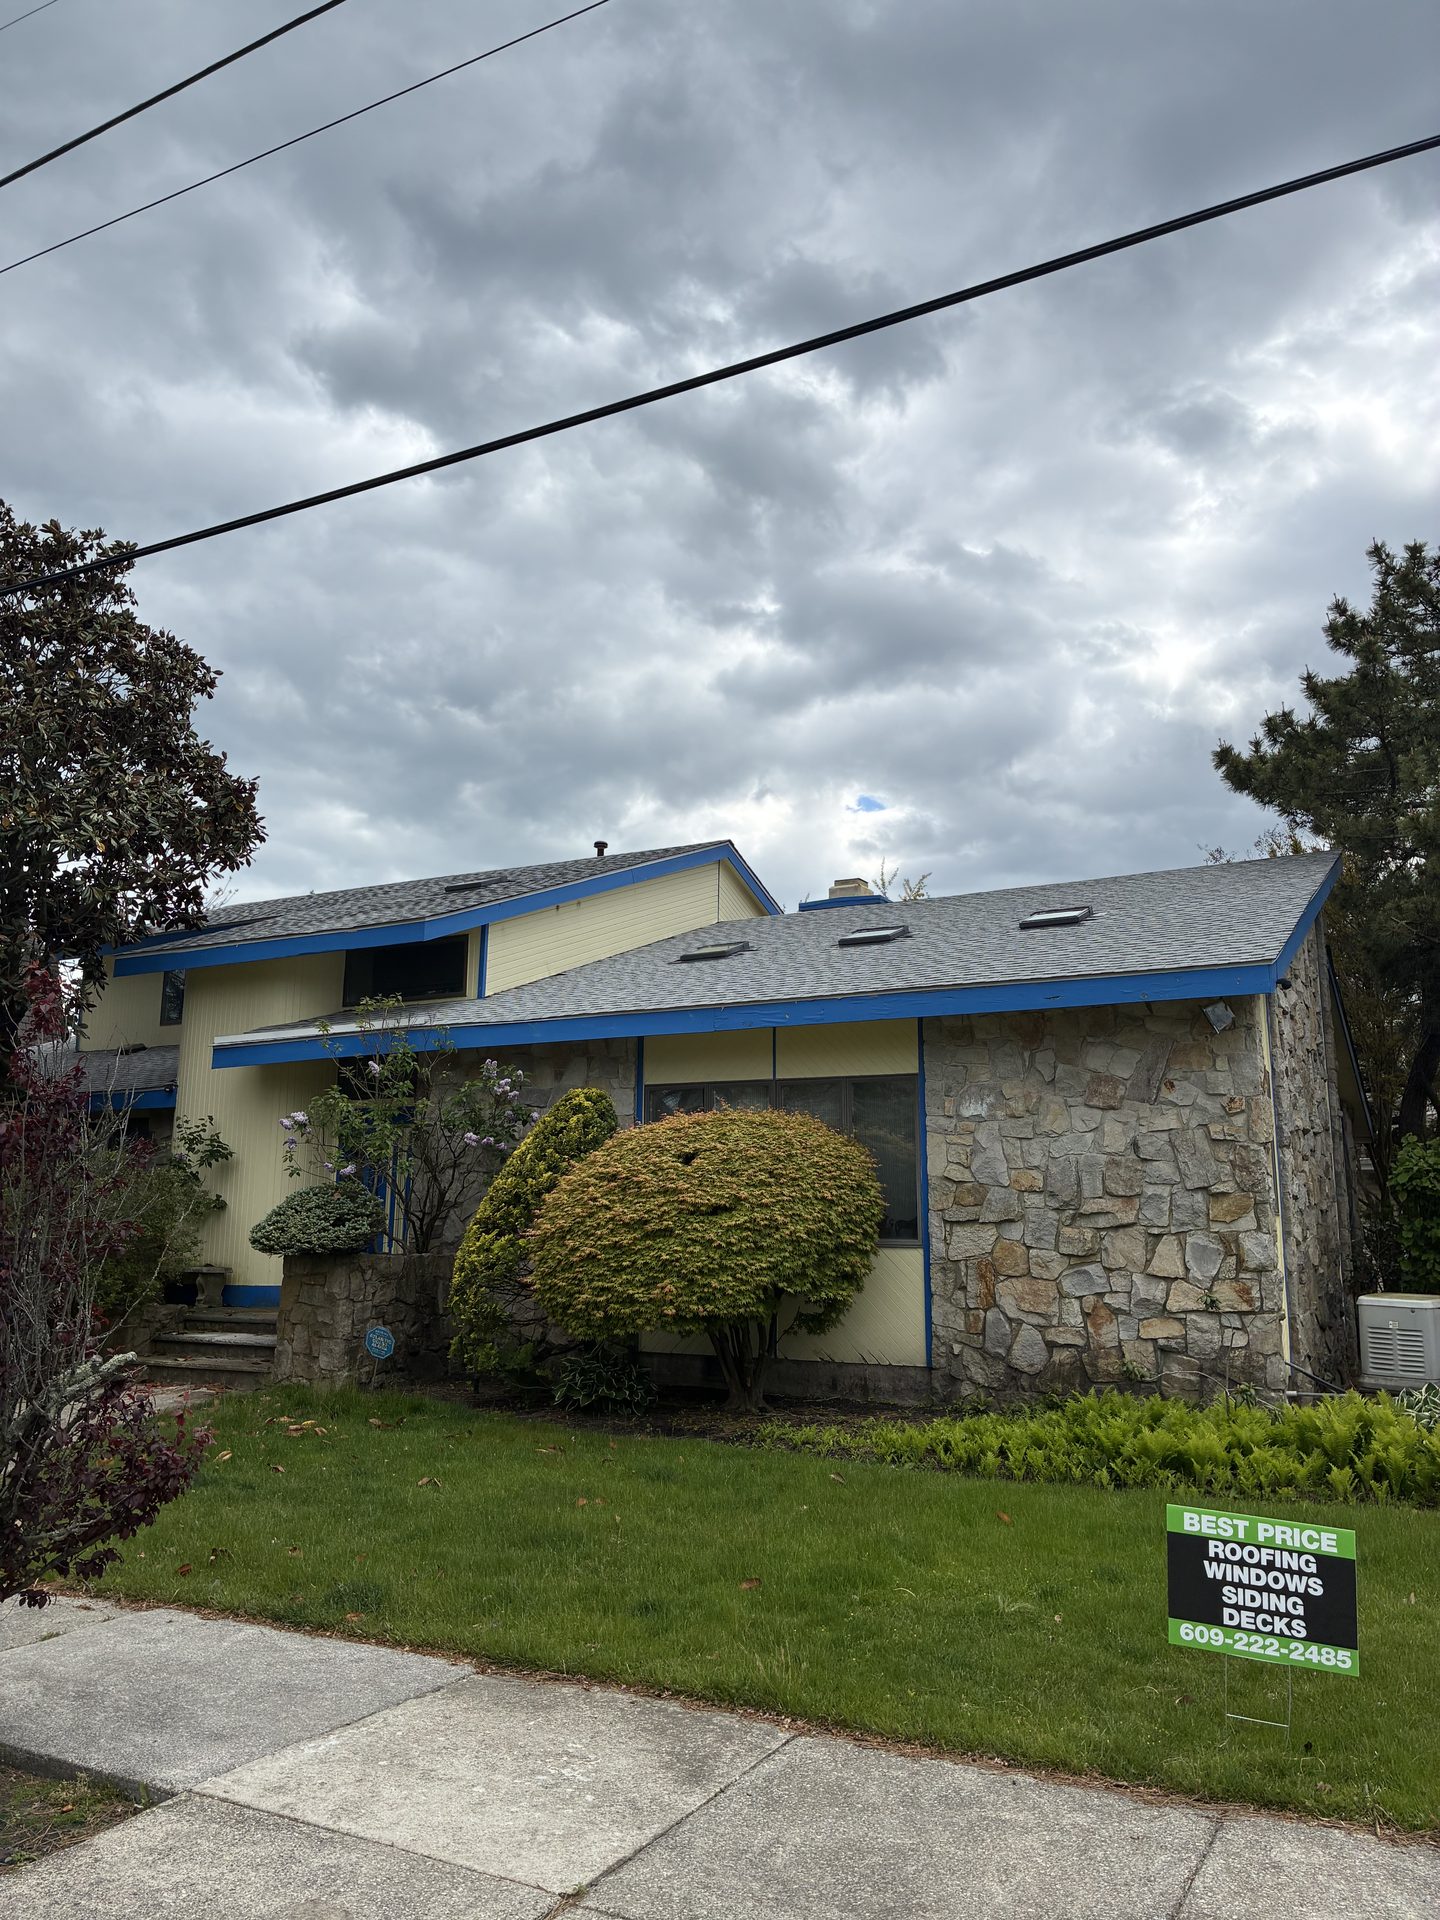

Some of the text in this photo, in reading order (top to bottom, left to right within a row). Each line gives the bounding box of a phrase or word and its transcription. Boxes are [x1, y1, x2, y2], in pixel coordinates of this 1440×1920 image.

[1183, 1512, 1338, 1553] BEST PRICE
[1208, 1540, 1317, 1574] ROOFING
[1203, 1560, 1324, 1597] WINDOWS
[1222, 1585, 1305, 1616] SIDING
[1222, 1607, 1307, 1638] DECKS
[1179, 1623, 1352, 1669] 609-222-2485
